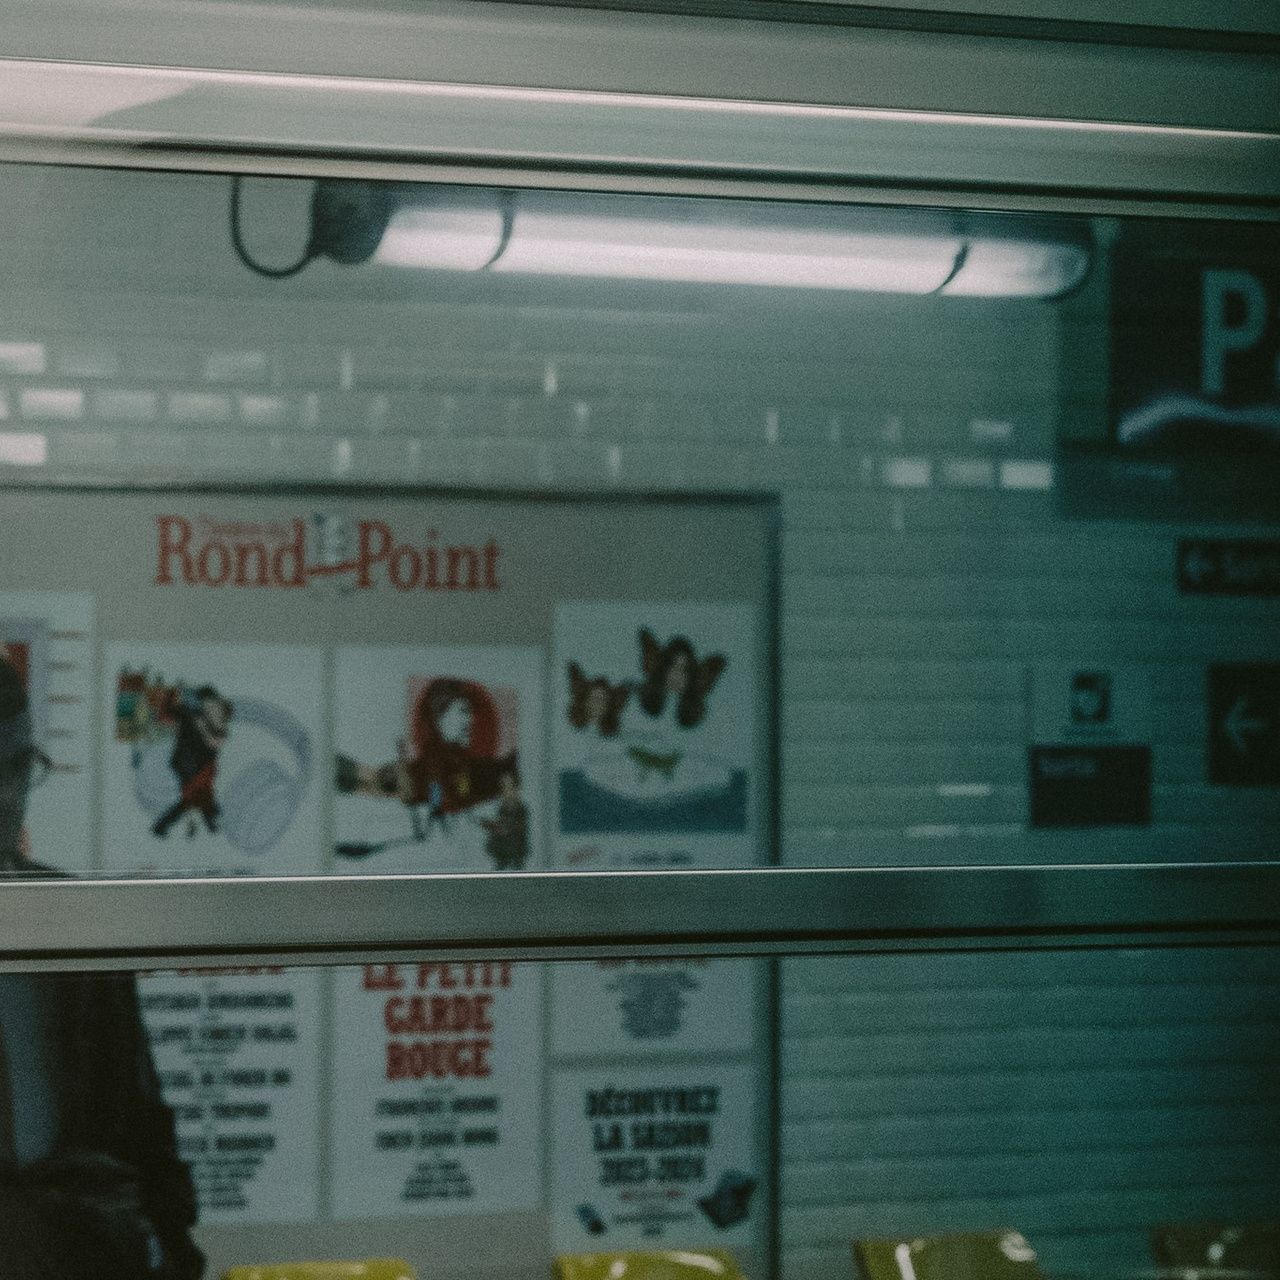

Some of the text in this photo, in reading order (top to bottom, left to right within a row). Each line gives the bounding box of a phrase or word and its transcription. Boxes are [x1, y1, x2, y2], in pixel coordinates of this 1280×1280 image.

[1202, 269, 1280, 393] P
[154, 514, 501, 593] Rond Point
[417, 962, 511, 989] PETIT
[384, 993, 494, 1034] GARDE
[385, 1038, 493, 1080] ROUGE
[593, 1121, 624, 1152] LA
